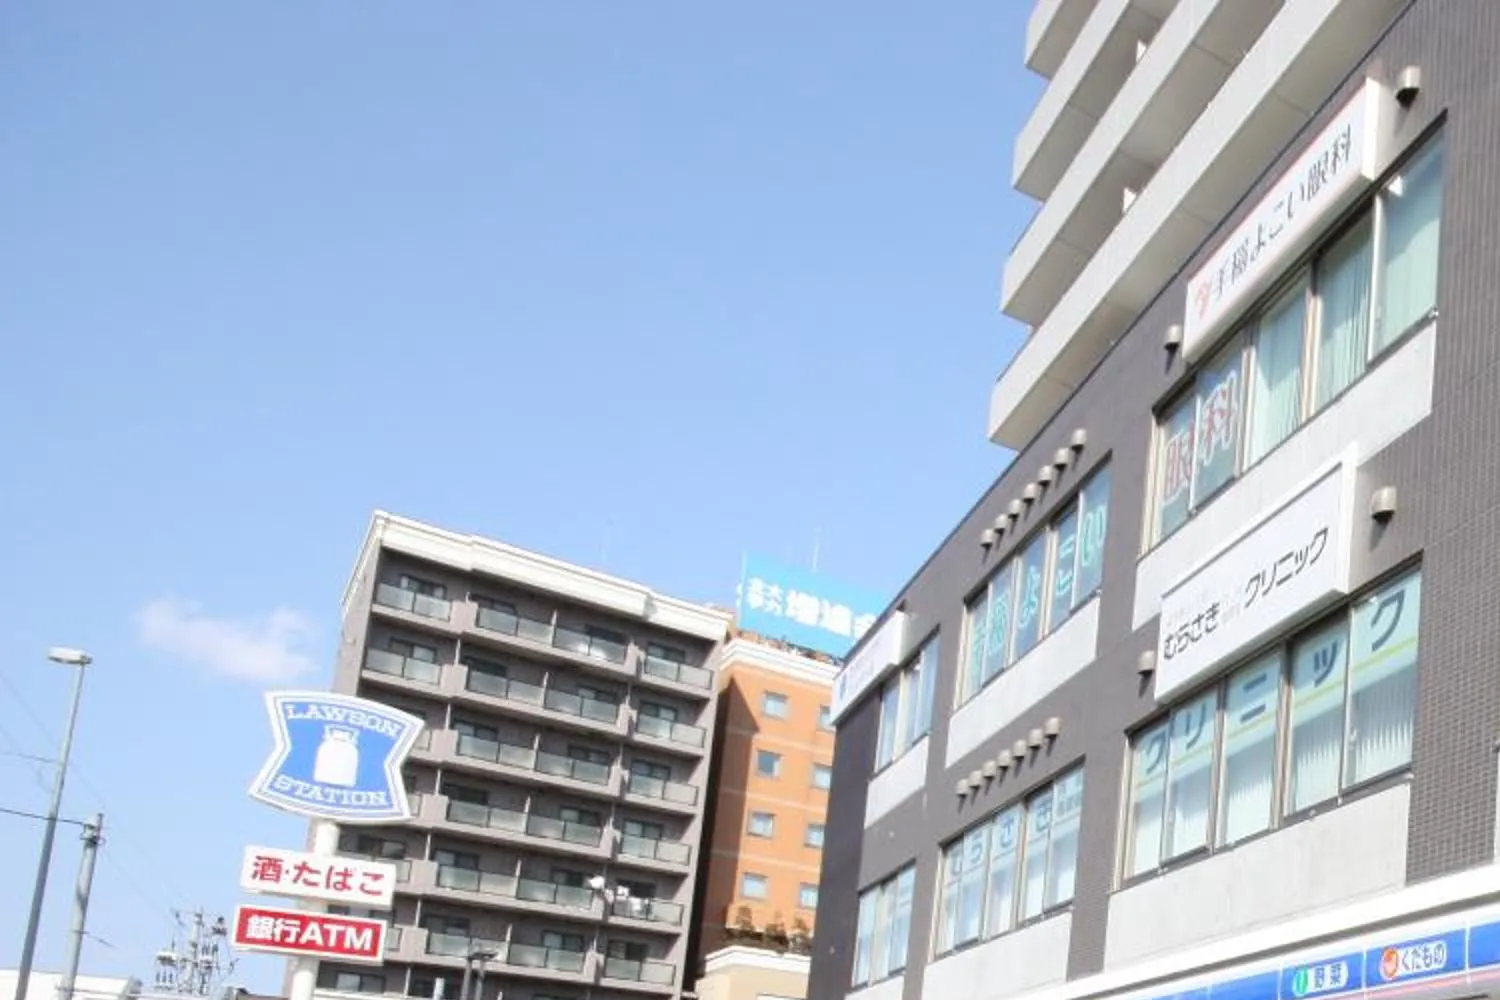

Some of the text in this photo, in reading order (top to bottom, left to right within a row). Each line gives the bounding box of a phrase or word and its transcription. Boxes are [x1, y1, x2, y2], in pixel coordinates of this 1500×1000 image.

[1163, 602, 1220, 660] むらさき
[1245, 528, 1328, 607] クリニック
[1146, 590, 1405, 774] クリニック
[285, 704, 401, 738] LAWSON
[275, 774, 388, 806] STATION
[246, 914, 374, 951] 銀行ATM
[1402, 942, 1446, 972] くだもの
[1313, 962, 1342, 989] 野菜
